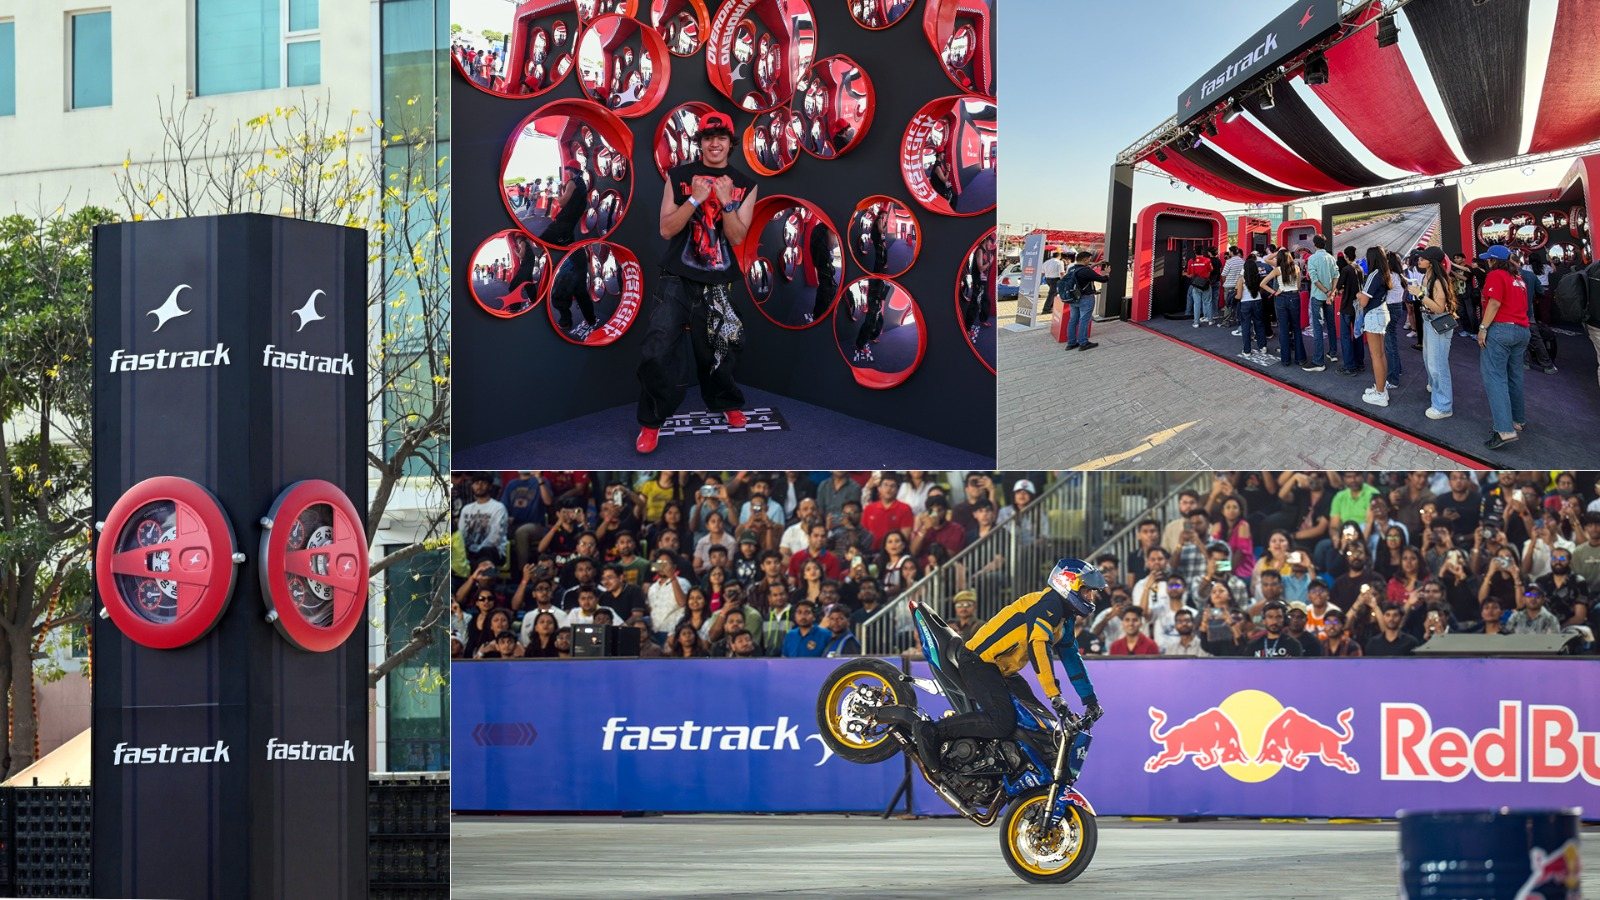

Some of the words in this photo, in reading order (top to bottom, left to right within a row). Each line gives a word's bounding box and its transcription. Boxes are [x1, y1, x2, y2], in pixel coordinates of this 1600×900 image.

[1200, 32, 1279, 100] fastrack
[109, 342, 231, 373] fastrack
[263, 344, 354, 376] fastrack
[663, 418, 693, 427] PIT
[602, 716, 801, 751] fastrack
[1381, 700, 1521, 782] Red
[113, 740, 230, 765] fastrack
[266, 737, 355, 762] fastrack
